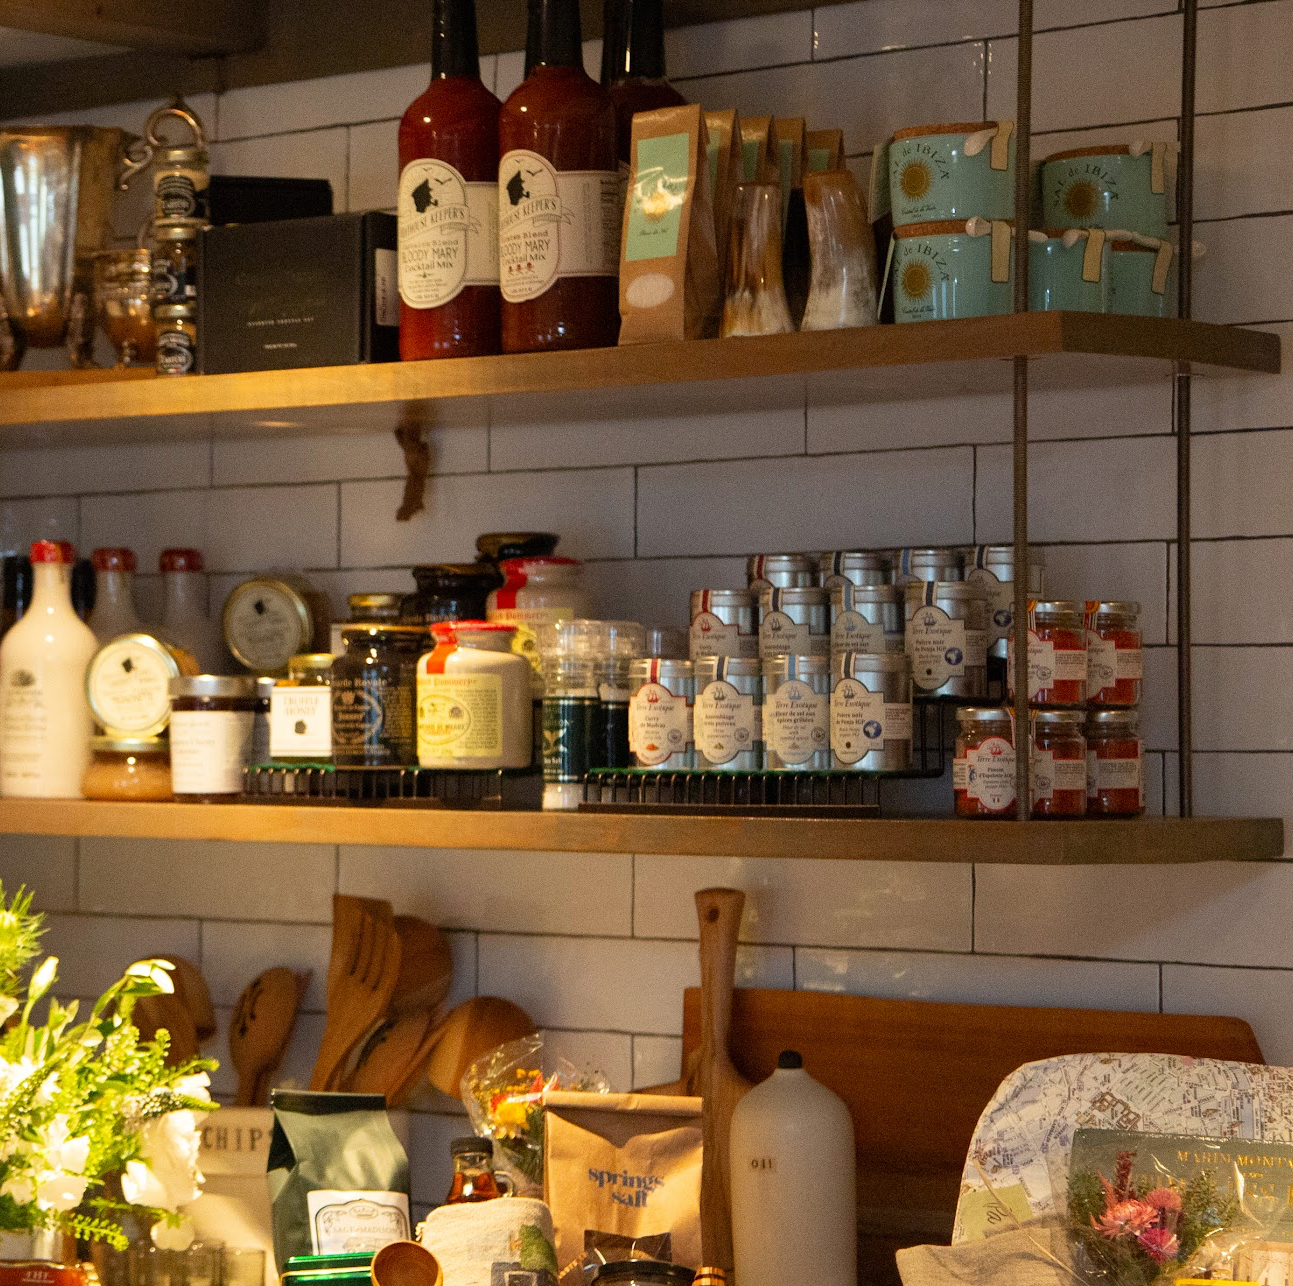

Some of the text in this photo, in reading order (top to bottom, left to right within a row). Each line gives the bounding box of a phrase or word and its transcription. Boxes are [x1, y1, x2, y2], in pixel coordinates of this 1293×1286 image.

[916, 143, 950, 179] IBIZA
[1084, 163, 1119, 200] IBIZA
[432, 247, 459, 261] MARY
[525, 239, 551, 252] MARY
[917, 243, 950, 281] IBIZA
[588, 1168, 665, 1191] springs
[611, 1190, 648, 1209] salt
